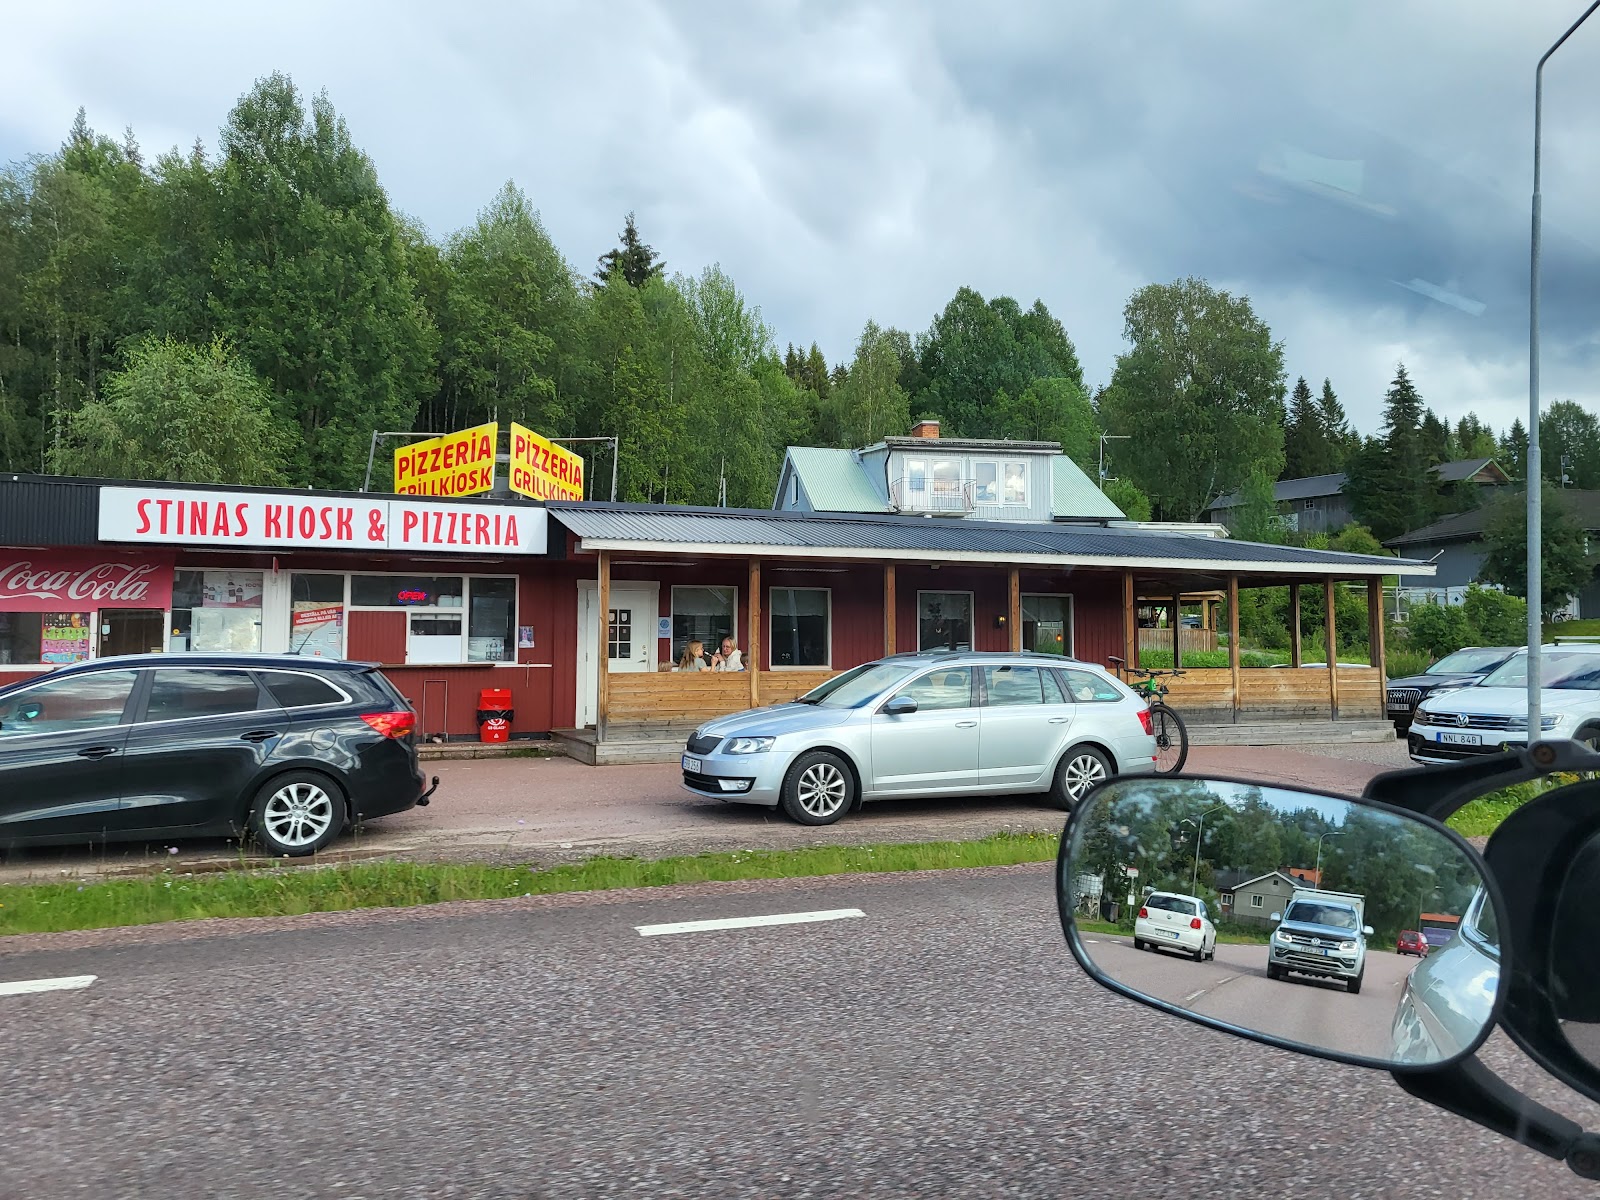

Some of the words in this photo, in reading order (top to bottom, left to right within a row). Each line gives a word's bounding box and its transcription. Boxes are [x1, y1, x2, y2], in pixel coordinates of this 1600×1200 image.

[136, 498, 249, 537] STINAS
[264, 504, 353, 540] KIOSK
[367, 508, 386, 542] &
[403, 510, 519, 546] PIZZERIA
[397, 591, 426, 601] OPEN
[1443, 734, 1458, 743] NNL
[1460, 735, 1477, 744] 84B
